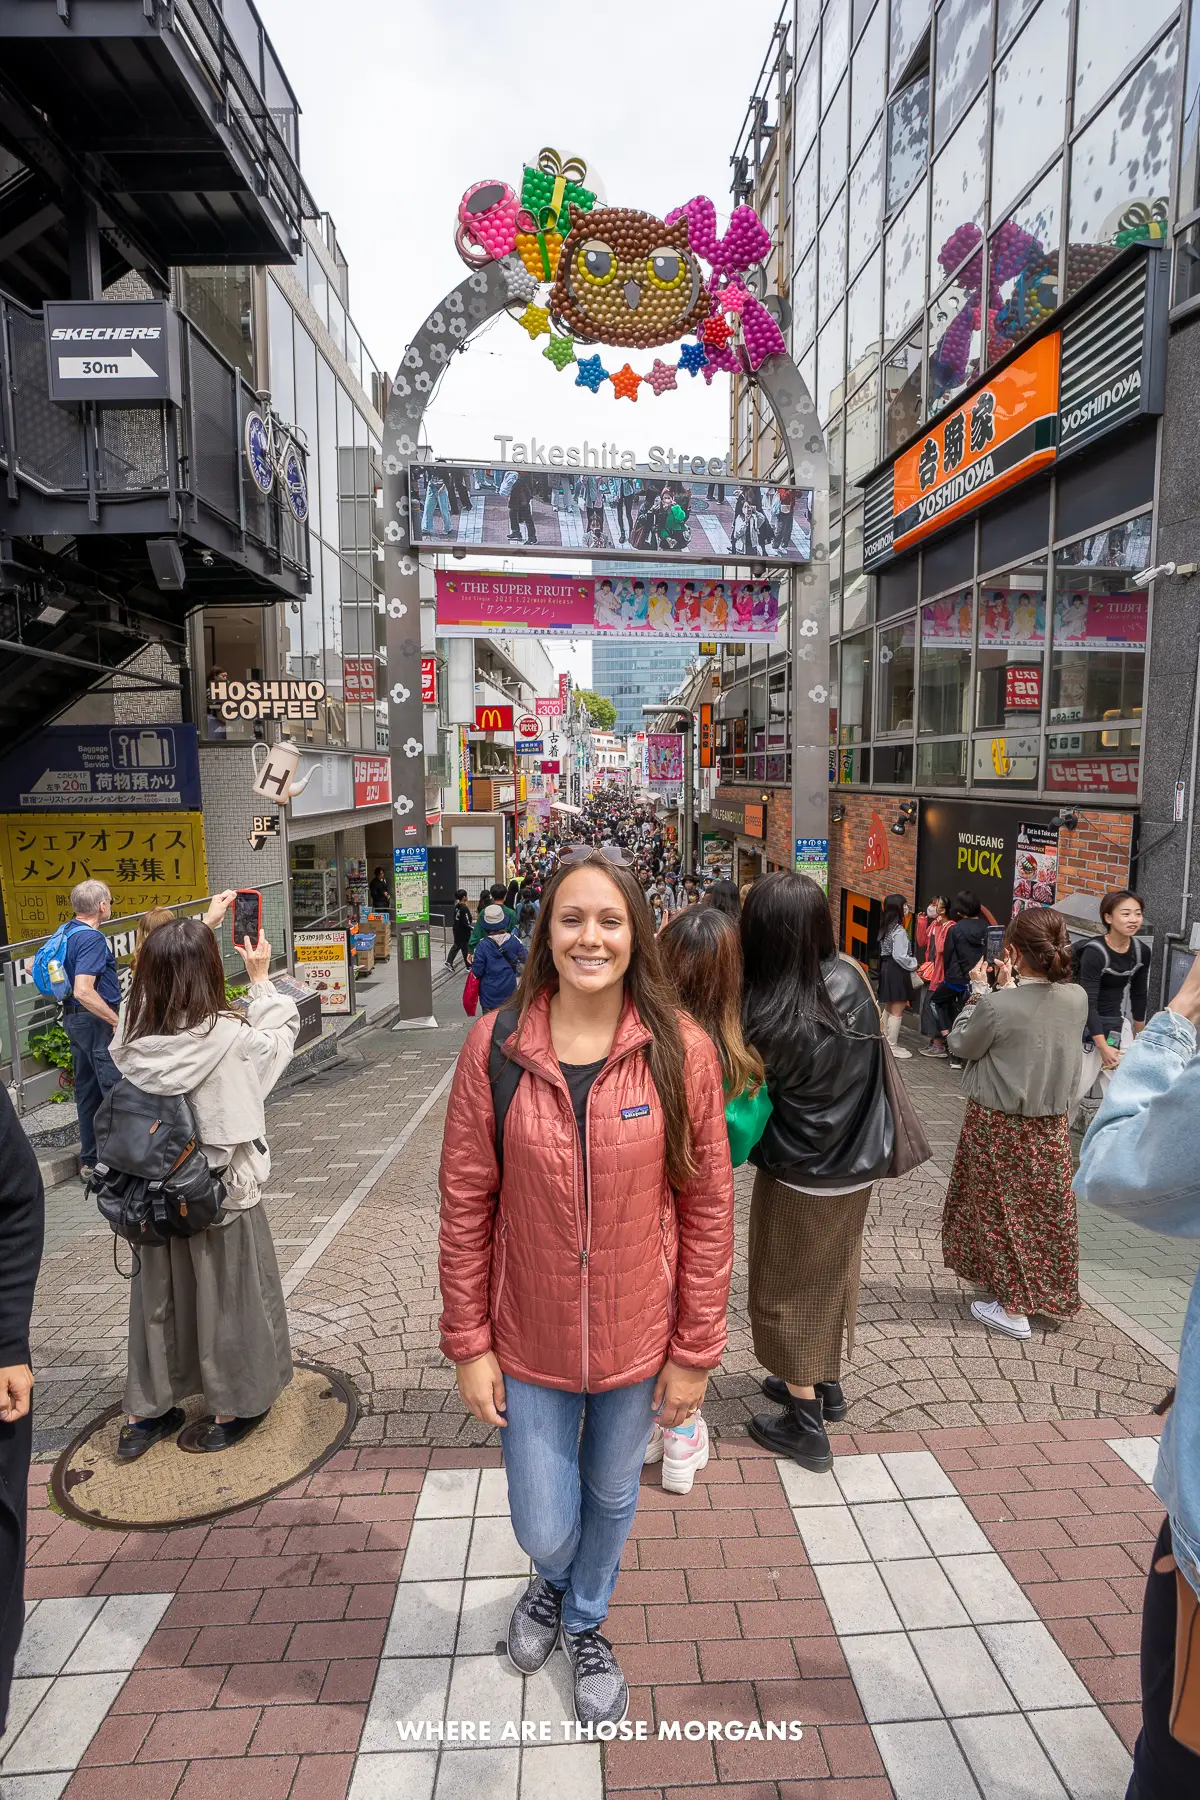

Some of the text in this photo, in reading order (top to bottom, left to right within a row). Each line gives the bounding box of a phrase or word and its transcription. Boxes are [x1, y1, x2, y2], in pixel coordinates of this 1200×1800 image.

[50, 327, 162, 341] SKECHERS
[82, 361, 119, 374] 30m
[1061, 369, 1142, 435] YOSHINOYA
[494, 434, 734, 478] Takeshita Street
[918, 456, 995, 523] YOSHINOYA
[461, 582, 575, 597] THE SUPER FRUIT
[210, 680, 325, 701] HOSHINO
[221, 700, 317, 720] COFFEE
[537, 705, 560, 715] ¥300
[78, 745, 109, 754] Baggage
[548, 732, 560, 758] 古着
[82, 753, 109, 762] Storage
[62, 779, 88, 792] 20m
[95, 772, 176, 791] 荷物預かり
[259, 763, 291, 796] H
[253, 816, 272, 832] BF
[15, 828, 187, 853] シェアオフィス
[957, 831, 1005, 850] WOLFGANG
[1041, 829, 1051, 837] Take
[957, 847, 1003, 879] PUCK
[19, 895, 44, 908] Job
[20, 908, 46, 921] Lab
[306, 969, 331, 978] ¥350
